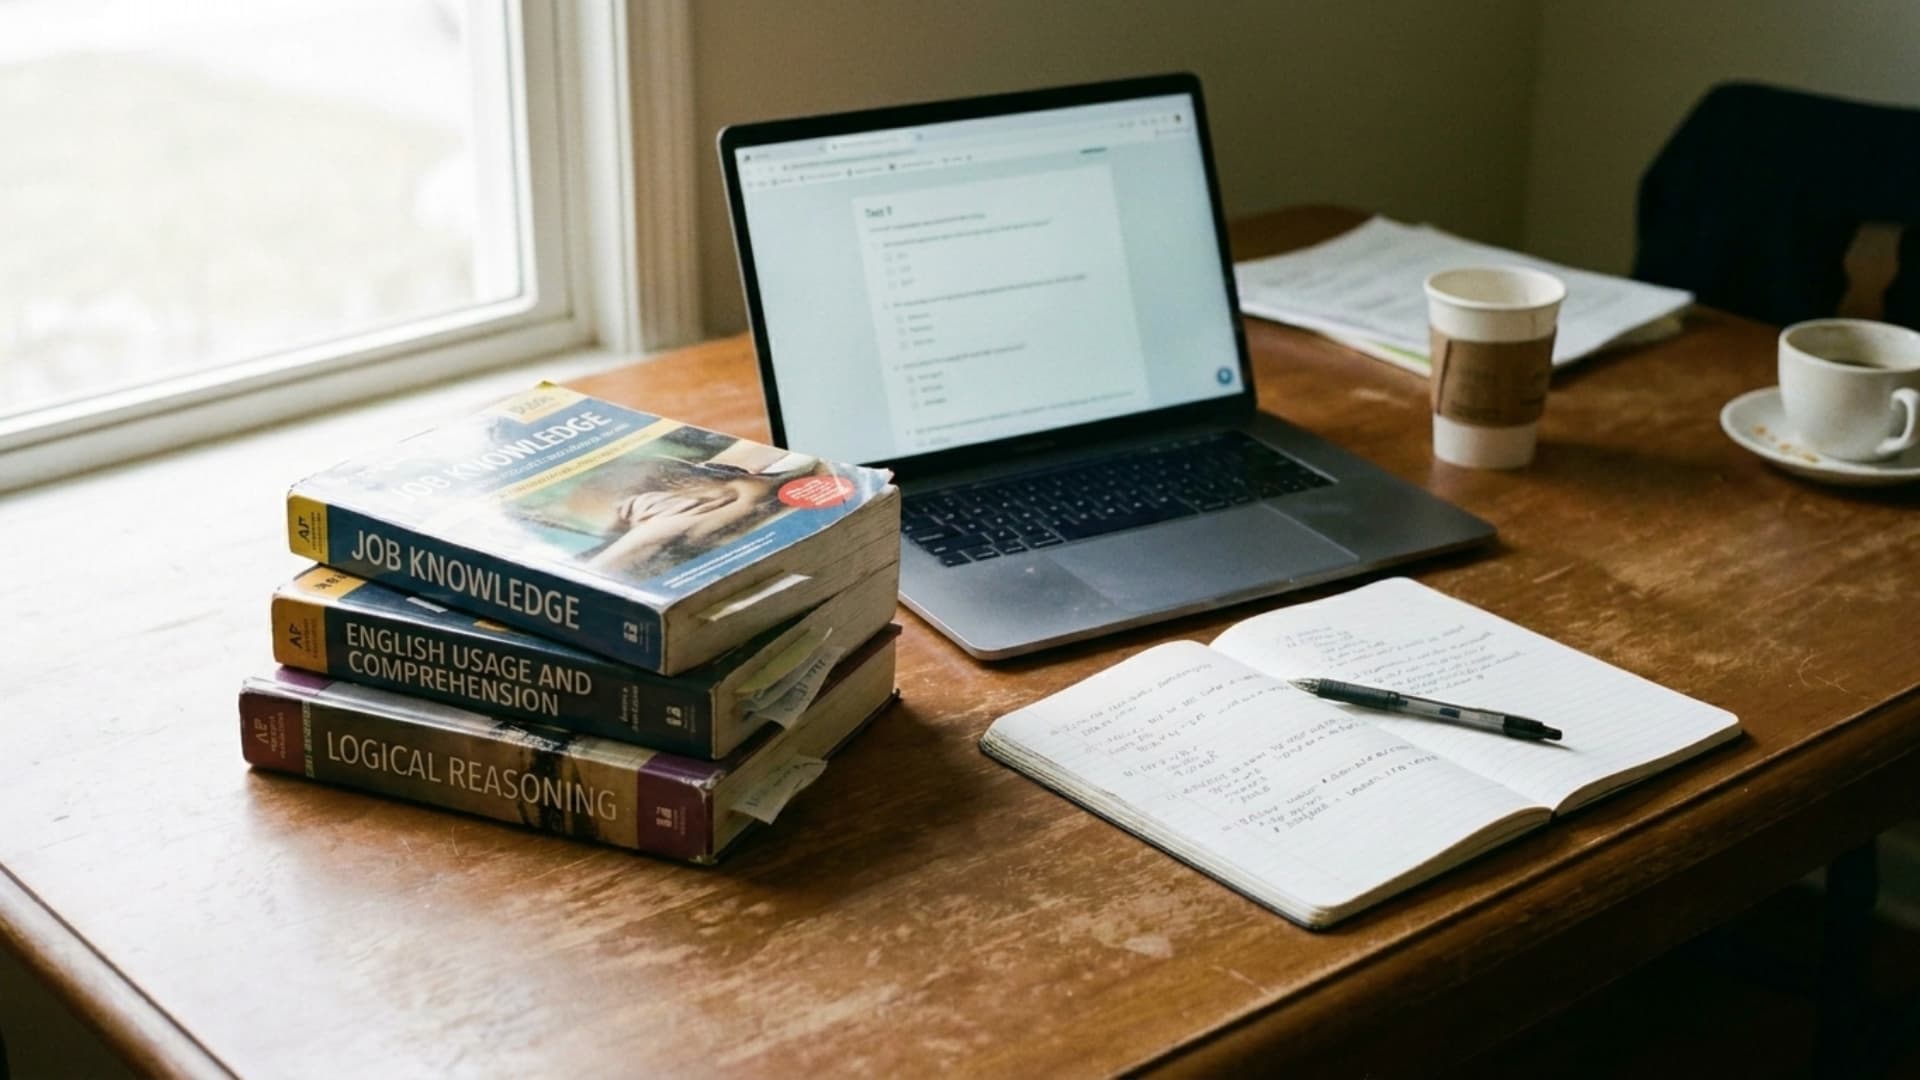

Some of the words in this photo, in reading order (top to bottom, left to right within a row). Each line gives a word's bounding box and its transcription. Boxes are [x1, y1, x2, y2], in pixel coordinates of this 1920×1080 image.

[444, 411, 614, 481] KNOWLEDGE
[351, 530, 401, 571] JOB
[410, 546, 580, 630] KNOWLEDGE
[346, 622, 445, 665] ENGLISH
[452, 644, 532, 684] USAGE
[538, 665, 592, 696] AND
[348, 650, 559, 717] COMPREHENSION
[327, 731, 442, 783] LOGICAL
[450, 757, 617, 821] REASONING
